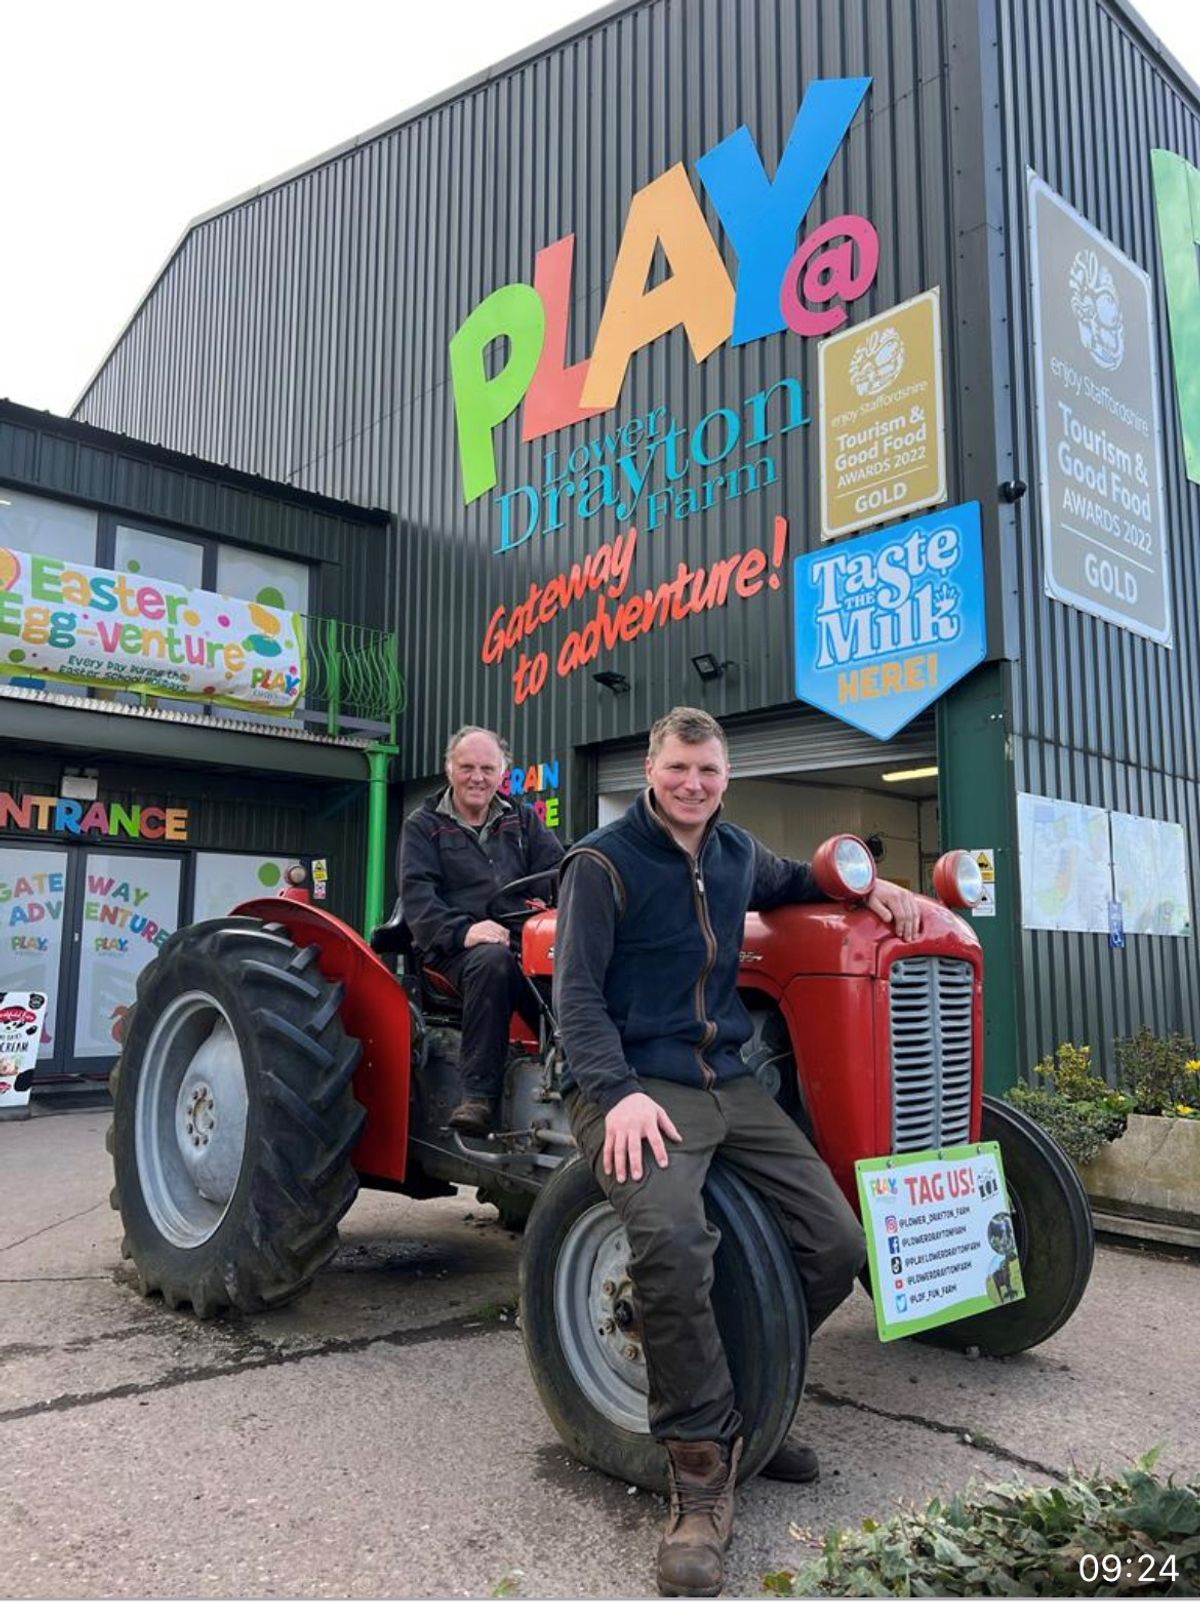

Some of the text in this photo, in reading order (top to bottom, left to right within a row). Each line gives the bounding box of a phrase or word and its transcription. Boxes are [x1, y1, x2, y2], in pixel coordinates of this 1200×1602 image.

[1050, 356, 1081, 396] enjoy
[831, 408, 858, 430] enjoy
[836, 405, 925, 450] Tourism &
[1058, 401, 1149, 486] Tourism &
[493, 377, 812, 555] Drayton
[544, 404, 666, 487] Lower
[835, 424, 927, 471] Good Food
[837, 446, 926, 488] AWARDS 2022
[645, 455, 778, 533] Farm
[855, 482, 907, 513] GOLD
[1058, 441, 1151, 523] Good Food
[1062, 488, 1153, 555] AWARDS 2022
[30, 554, 187, 626] Easter
[482, 526, 637, 665] Gateway
[844, 592, 876, 609] THE
[1084, 553, 1138, 604] GOLD
[512, 514, 788, 704] to adventure!
[816, 582, 960, 669] Milk
[838, 652, 938, 704] HERE!
[498, 759, 559, 796] GRAIN
[0, 792, 188, 841] NTRANCE
[904, 1172, 945, 1206] TAG
[946, 1167, 976, 1198] US!
